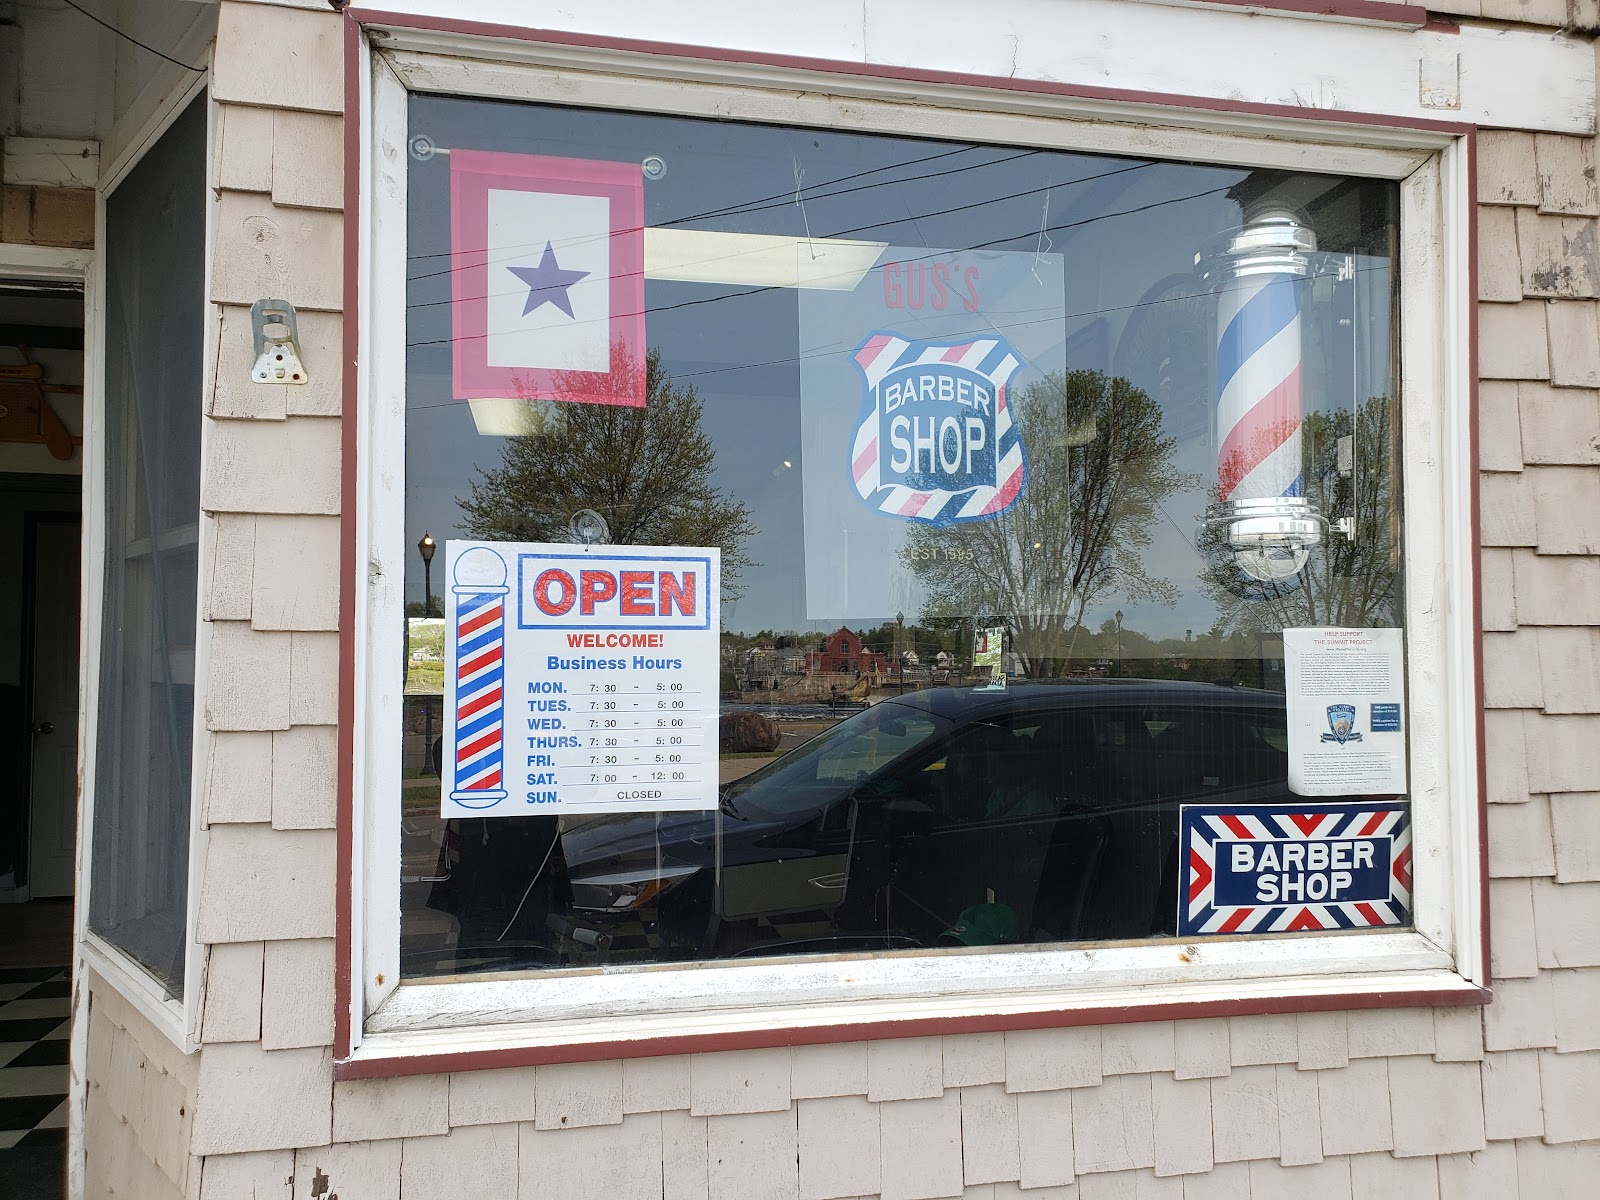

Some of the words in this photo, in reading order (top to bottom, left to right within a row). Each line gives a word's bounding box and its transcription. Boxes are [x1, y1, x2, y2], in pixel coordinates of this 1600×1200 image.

[884, 261, 980, 312] GUS'S
[885, 375, 990, 416] BARBER
[890, 415, 986, 475] SHOP
[910, 548, 940, 560] EST
[533, 568, 696, 617] OPEN
[566, 634, 664, 648] WELCOME!
[547, 656, 627, 670] Business
[632, 656, 682, 670] Hours
[527, 682, 568, 694] MON.
[528, 700, 572, 712] TUES.
[527, 718, 566, 730] WED.
[526, 736, 582, 748] THURS.
[526, 754, 555, 766] FRI.
[526, 773, 558, 785] SAT.
[526, 792, 562, 804] SUN.
[617, 790, 662, 800] CLOSED
[1232, 842, 1374, 872] BARBER
[1256, 872, 1352, 902] SHOP
